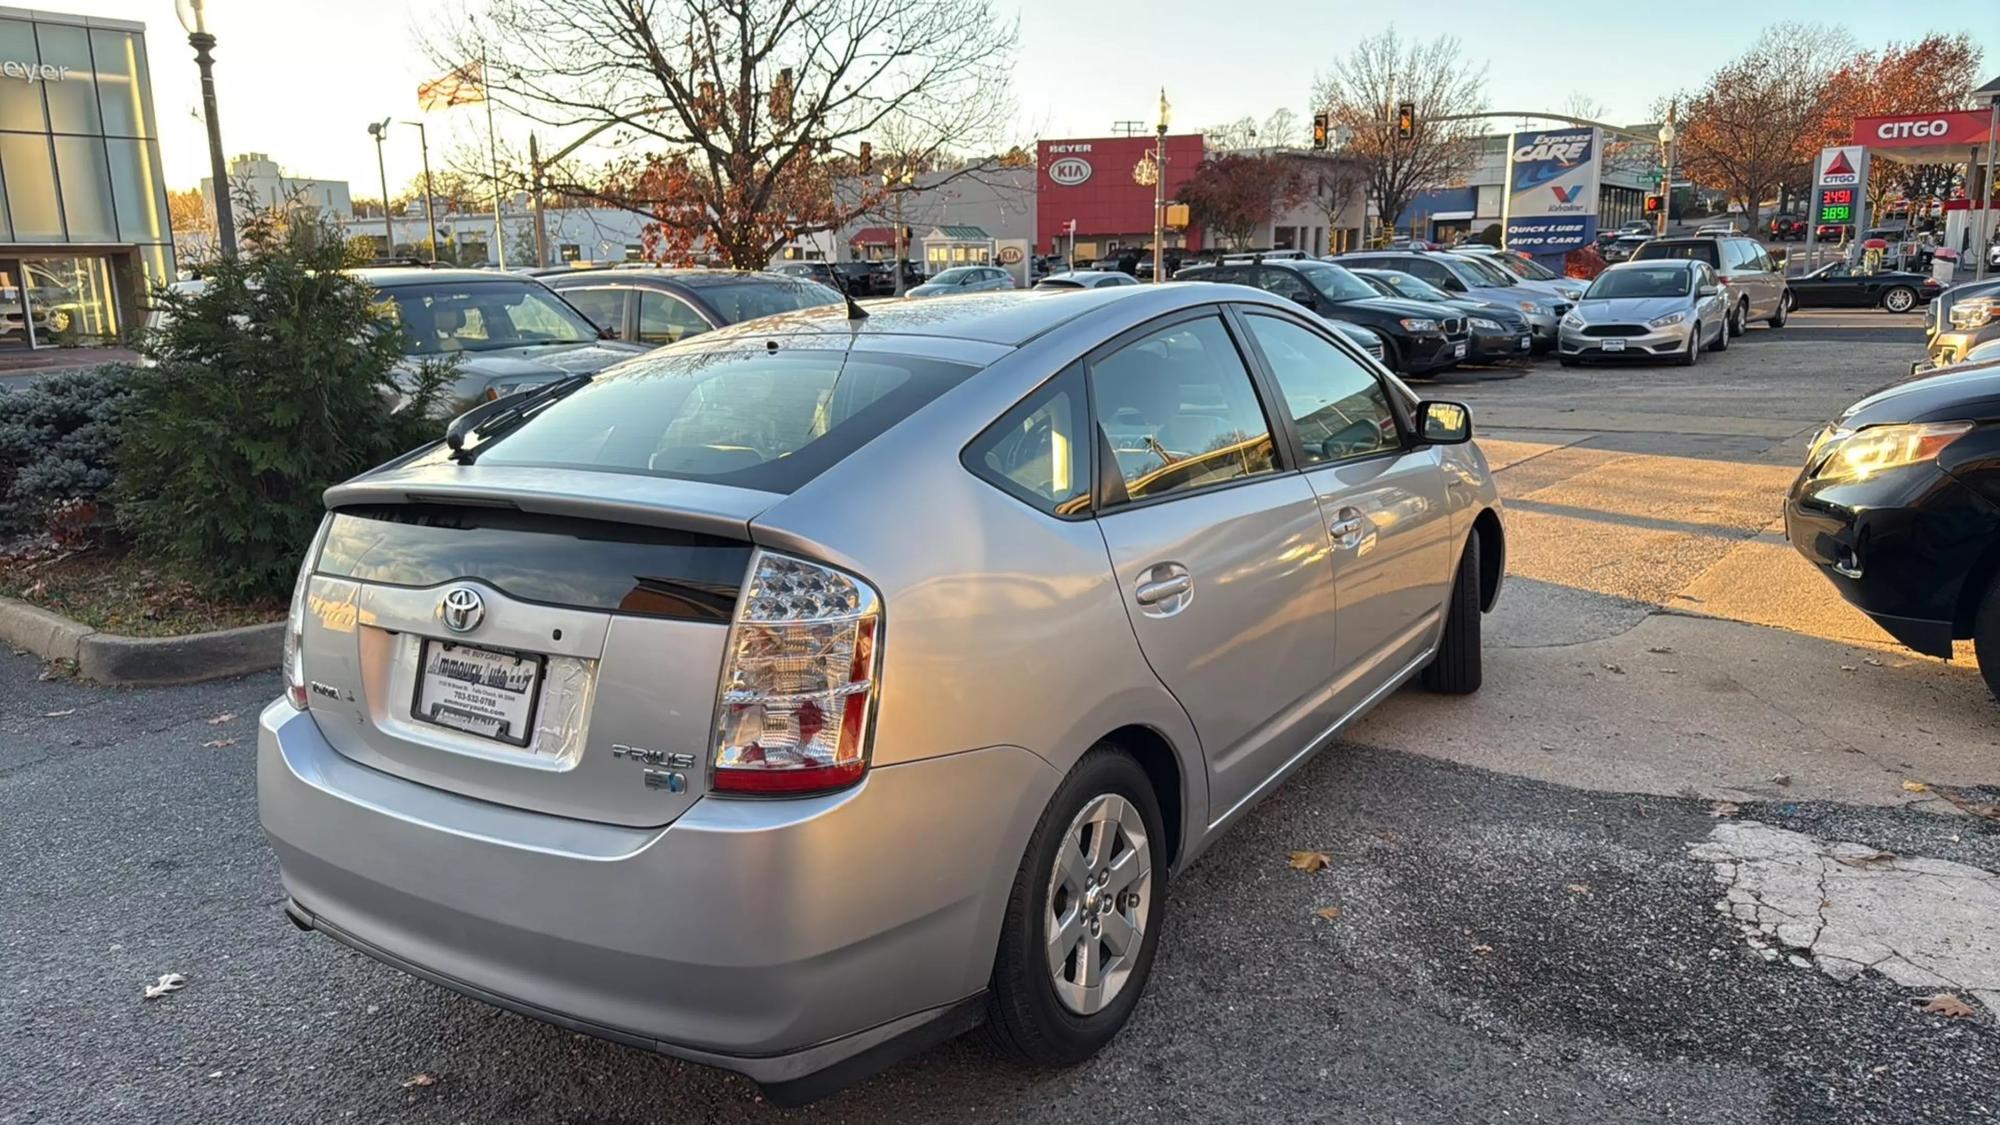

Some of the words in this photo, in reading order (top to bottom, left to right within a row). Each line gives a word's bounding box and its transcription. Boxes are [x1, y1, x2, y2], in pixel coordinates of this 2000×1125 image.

[1878, 120, 1948, 139] CITGO
[1533, 134, 1592, 146] Express
[1050, 144, 1092, 153] BEYER
[1513, 142, 1588, 166] CARE
[1057, 165, 1084, 177] KIA
[1823, 175, 1855, 184] CITGO
[1508, 225, 1548, 234] QUICK
[1549, 224, 1584, 232] LUBE
[1508, 237, 1544, 245] AUTO
[1546, 236, 1583, 244] CARE
[1003, 251, 1019, 260] KIA
[427, 652, 483, 686] Ammoury
[480, 662, 508, 690] Auto
[444, 699, 505, 716] ammouryauto.com
[612, 744, 696, 769] PRIUS
